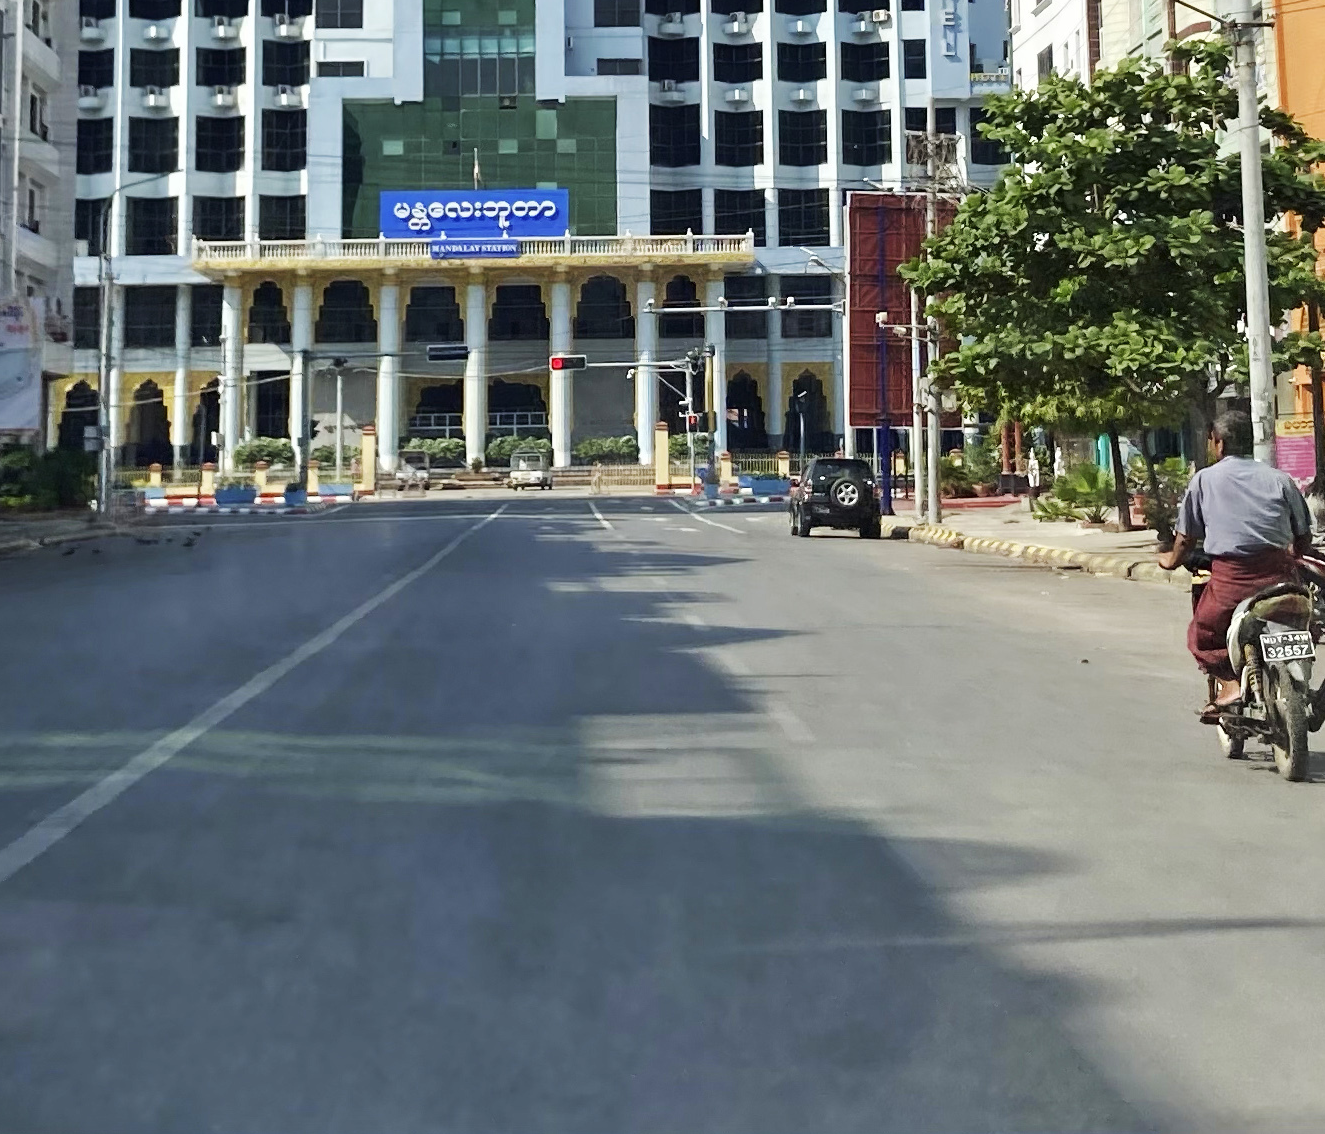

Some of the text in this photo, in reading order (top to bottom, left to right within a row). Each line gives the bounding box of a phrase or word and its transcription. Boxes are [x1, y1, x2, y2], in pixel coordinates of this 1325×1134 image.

[393, 201, 556, 231] မန္တလေးဘူတာ
[432, 244, 517, 253] MANDALAY STATION
[1267, 644, 1309, 659] 32557
